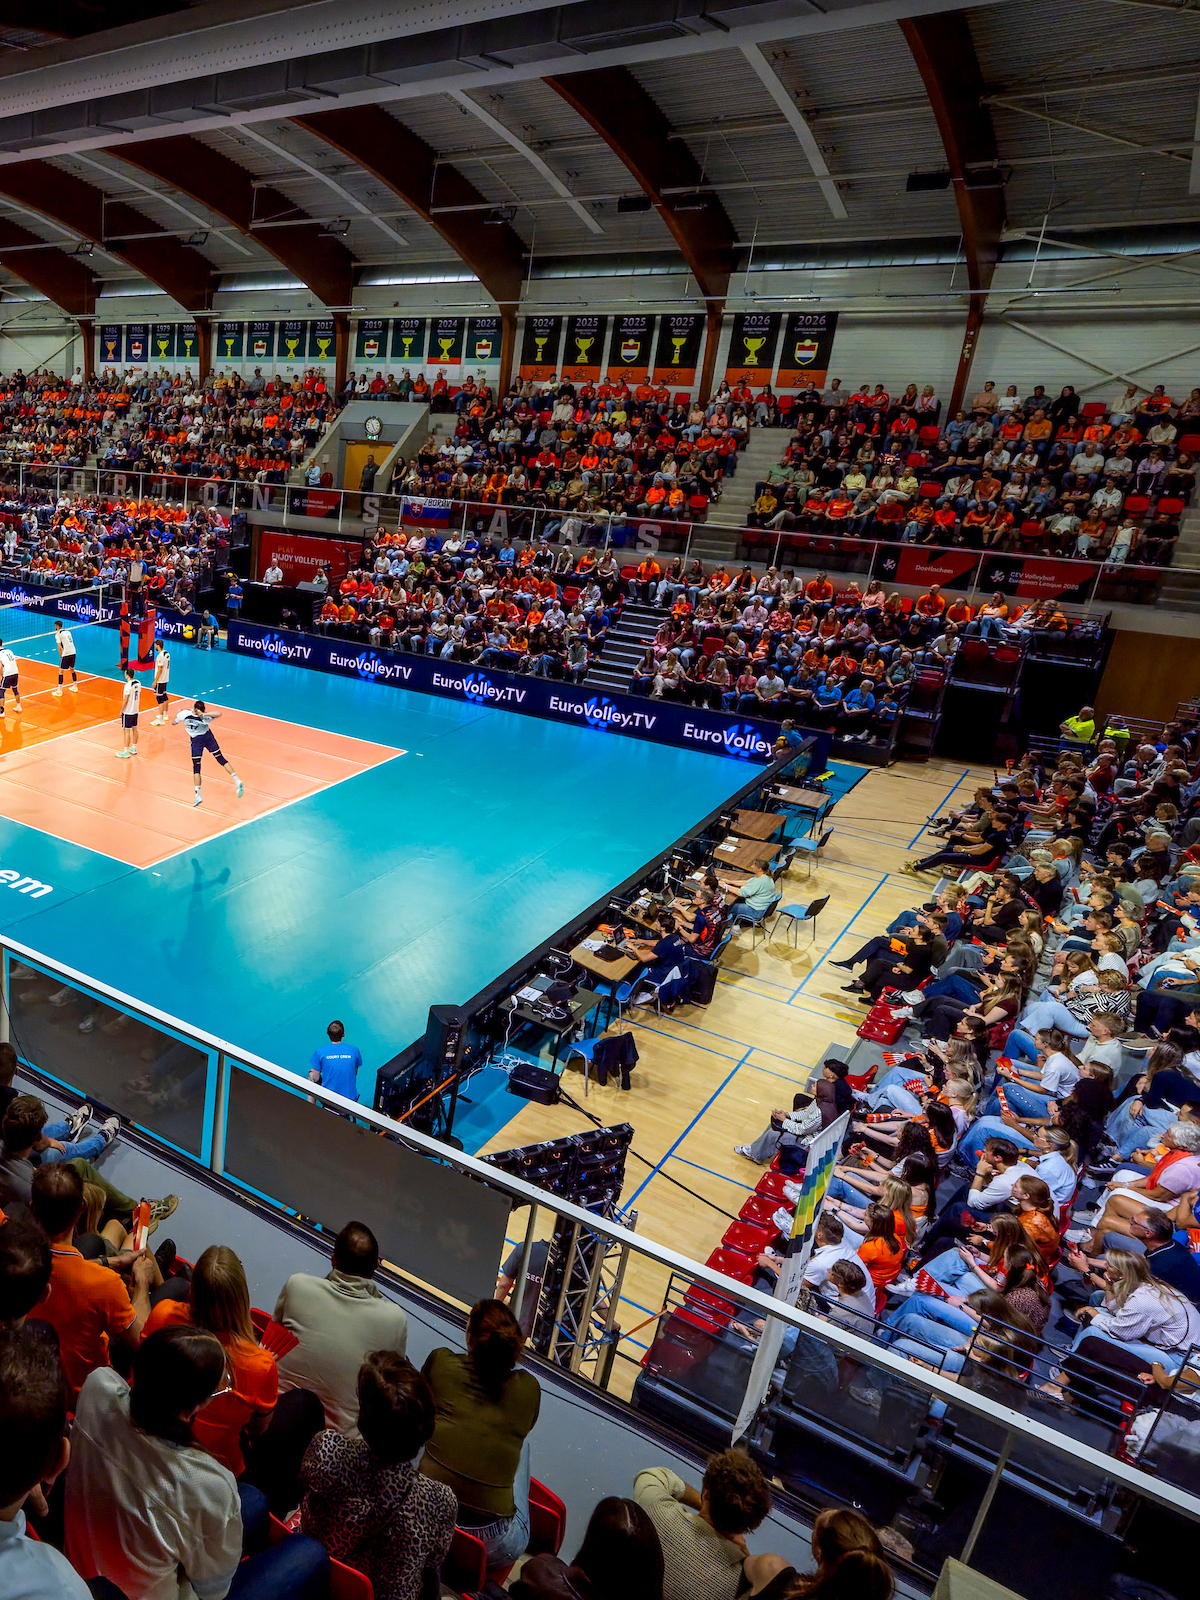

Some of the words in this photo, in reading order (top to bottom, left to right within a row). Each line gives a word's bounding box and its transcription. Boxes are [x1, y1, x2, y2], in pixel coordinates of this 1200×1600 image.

[364, 321, 382, 329] 2019
[400, 320, 419, 329] 2019
[438, 320, 458, 328] 2024
[476, 319, 496, 328] 2024
[532, 318, 554, 327] 2024
[576, 318, 598, 326] 2025
[622, 317, 646, 326] 2025
[670, 317, 694, 326] 2025
[743, 316, 770, 325] 2026
[798, 316, 826, 325] 2026
[285, 322, 301, 330] 2013
[317, 322, 333, 330] 2017
[272, 552, 293, 561] ENJOY
[915, 565, 953, 574] Doetinchem
[1025, 573, 1055, 582] Volleyball
[1008, 578, 1036, 587] European
[1038, 581, 1061, 590] League
[238, 634, 312, 660] EuroVolley.TV
[329, 652, 413, 680] EuroVolley.TV
[432, 672, 527, 703] EuroVolley.TV
[549, 695, 657, 730] EuroVolley.TV
[683, 722, 774, 758] EuroVolley
